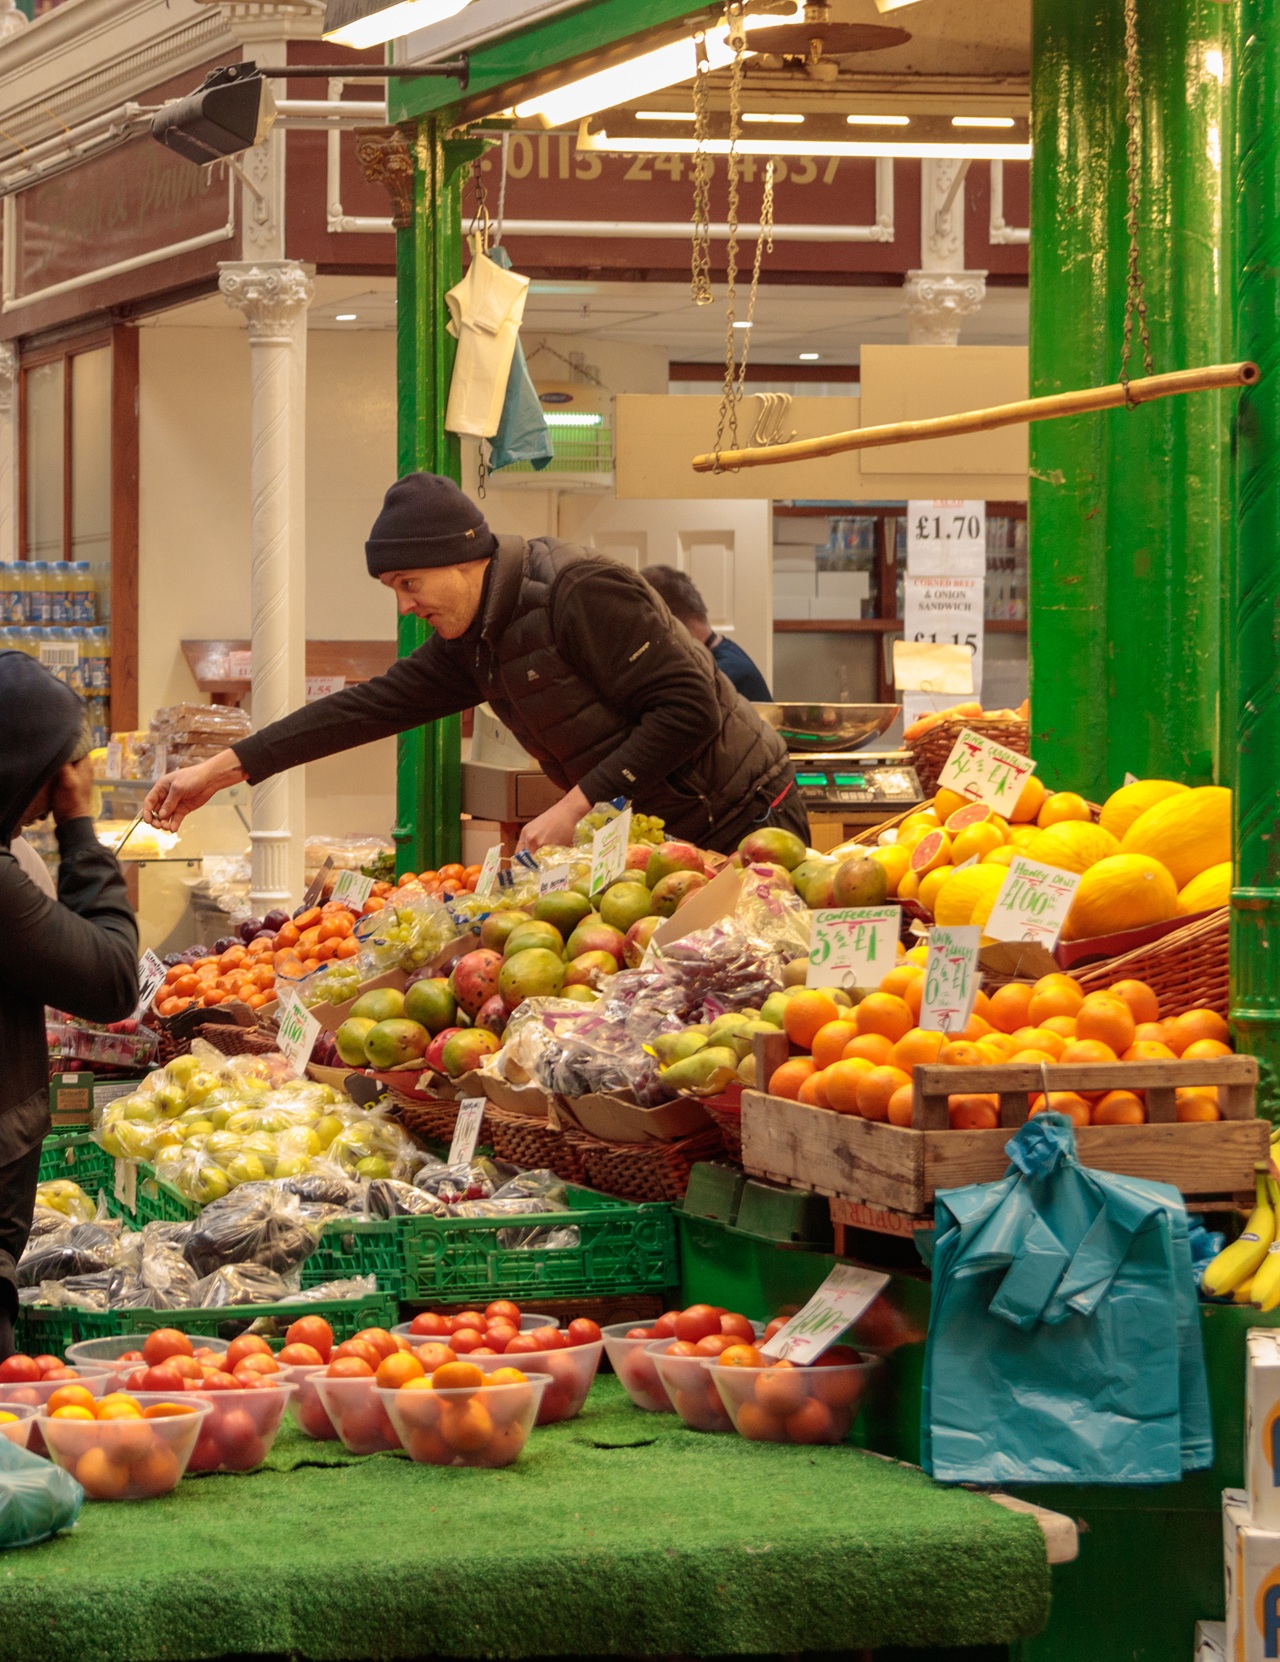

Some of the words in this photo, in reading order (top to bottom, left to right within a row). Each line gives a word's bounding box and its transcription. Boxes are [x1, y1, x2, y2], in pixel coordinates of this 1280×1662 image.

[506, 134, 603, 180] 0113
[915, 515, 980, 541] £1.70
[913, 578, 951, 588] CORNED
[934, 590, 966, 599] ONION
[918, 602, 972, 612] SANDWICH
[816, 908, 899, 923] CONFERENCE
